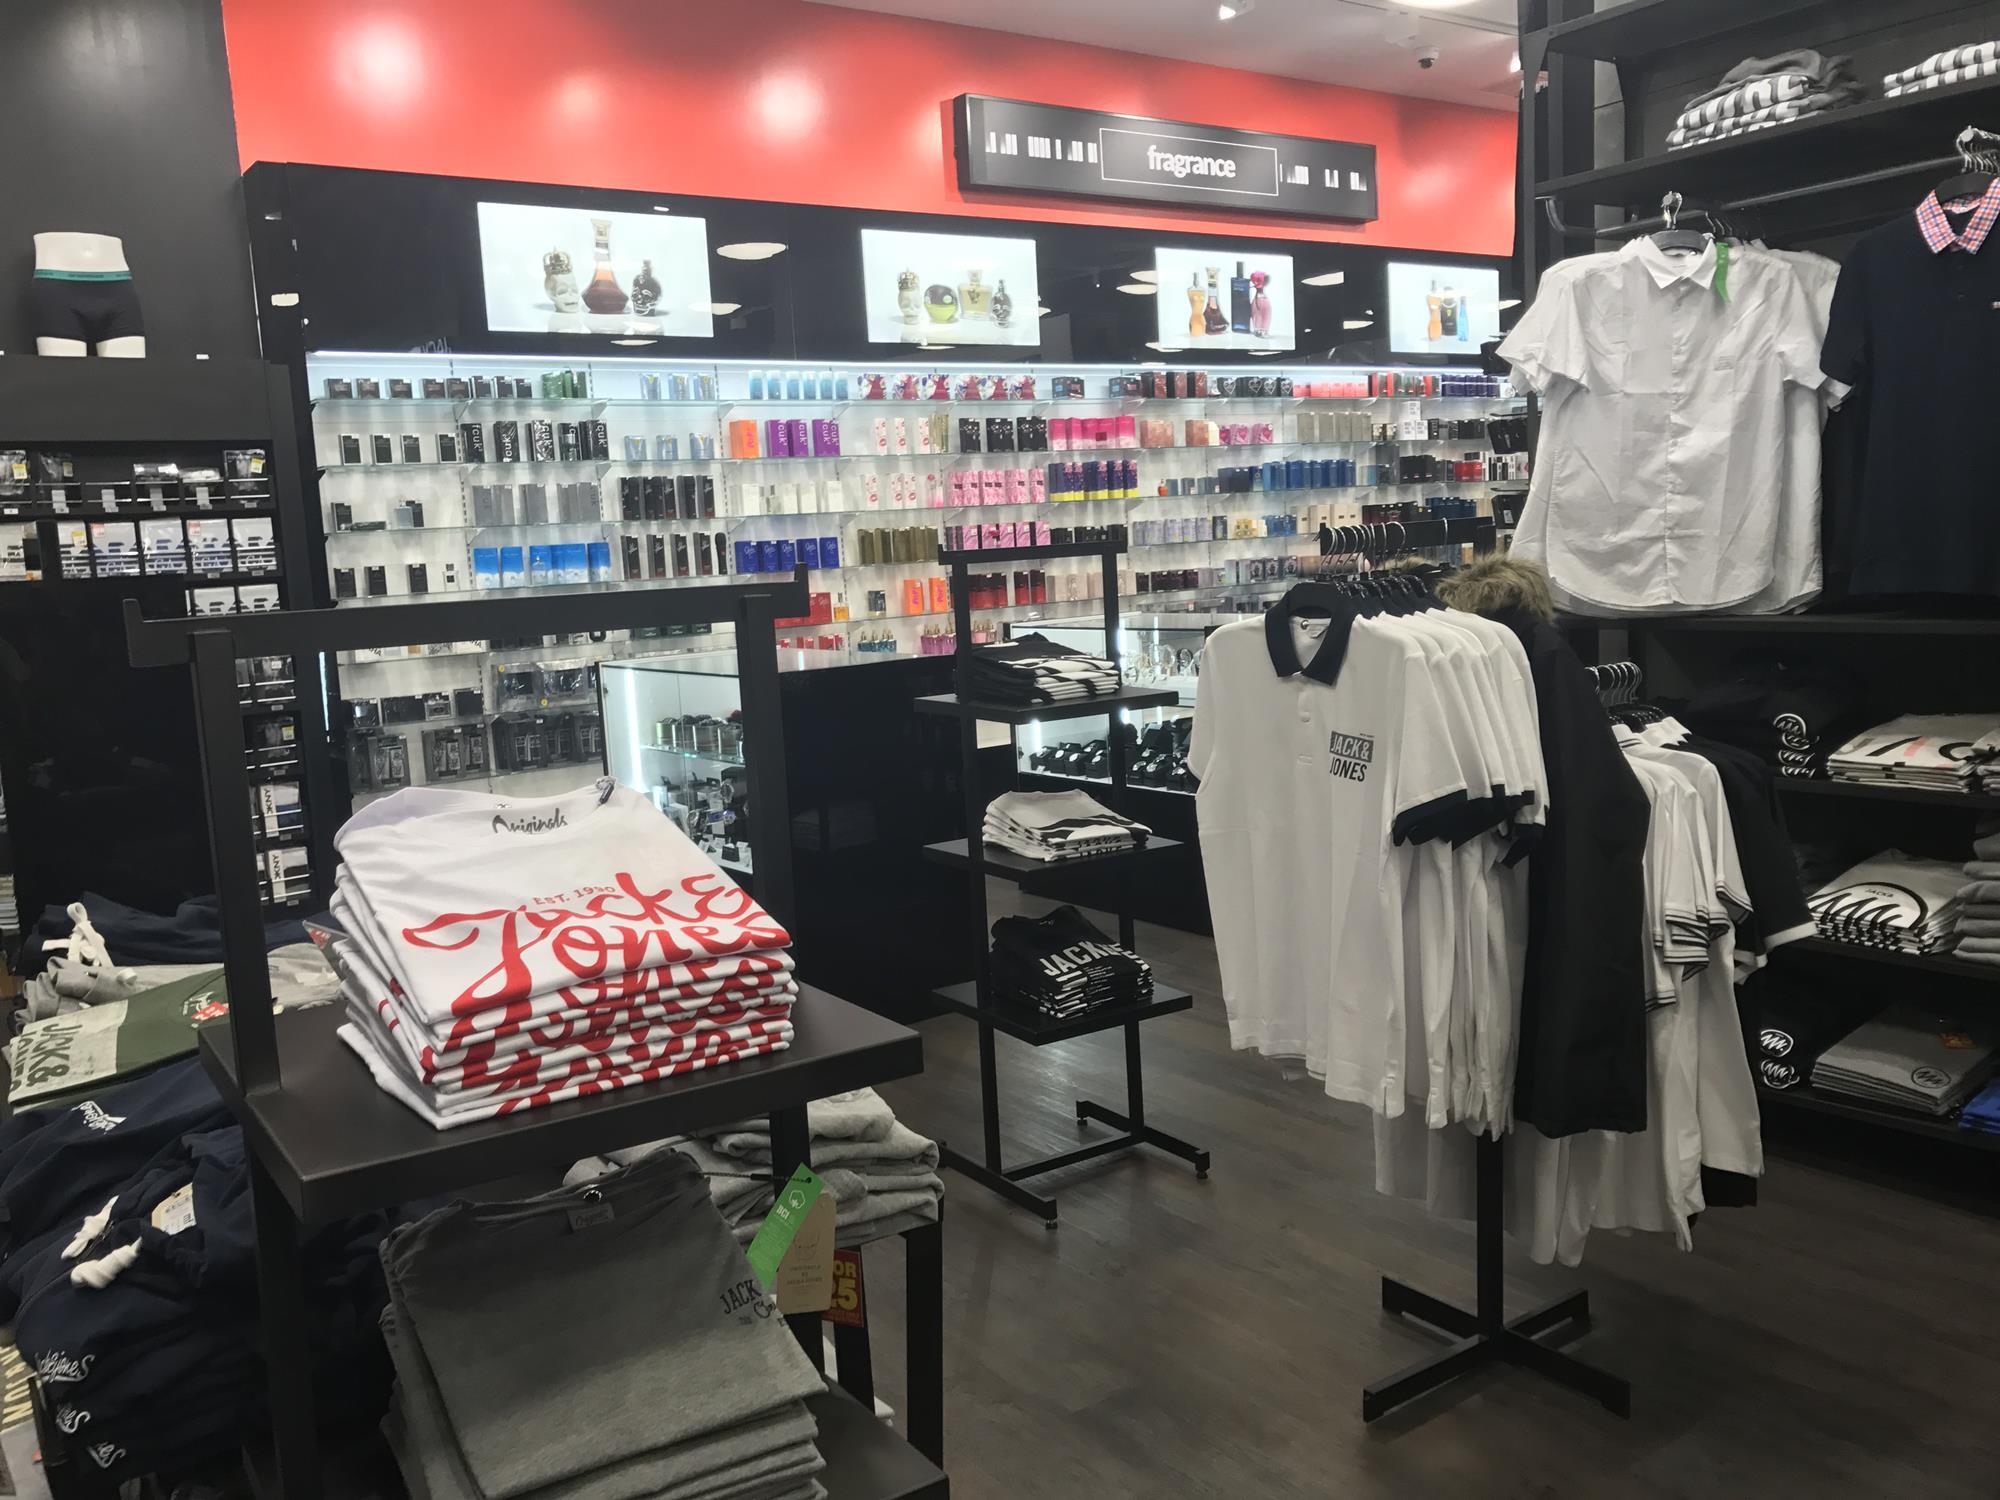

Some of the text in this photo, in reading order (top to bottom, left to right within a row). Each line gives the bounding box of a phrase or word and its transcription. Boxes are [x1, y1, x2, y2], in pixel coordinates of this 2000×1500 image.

[1147, 145, 1236, 178] fragrance
[1331, 734, 1370, 760] JACK&
[1329, 756, 1368, 782] JONES
[532, 884, 617, 907] EST. 1990
[720, 1278, 763, 1315] JACK
